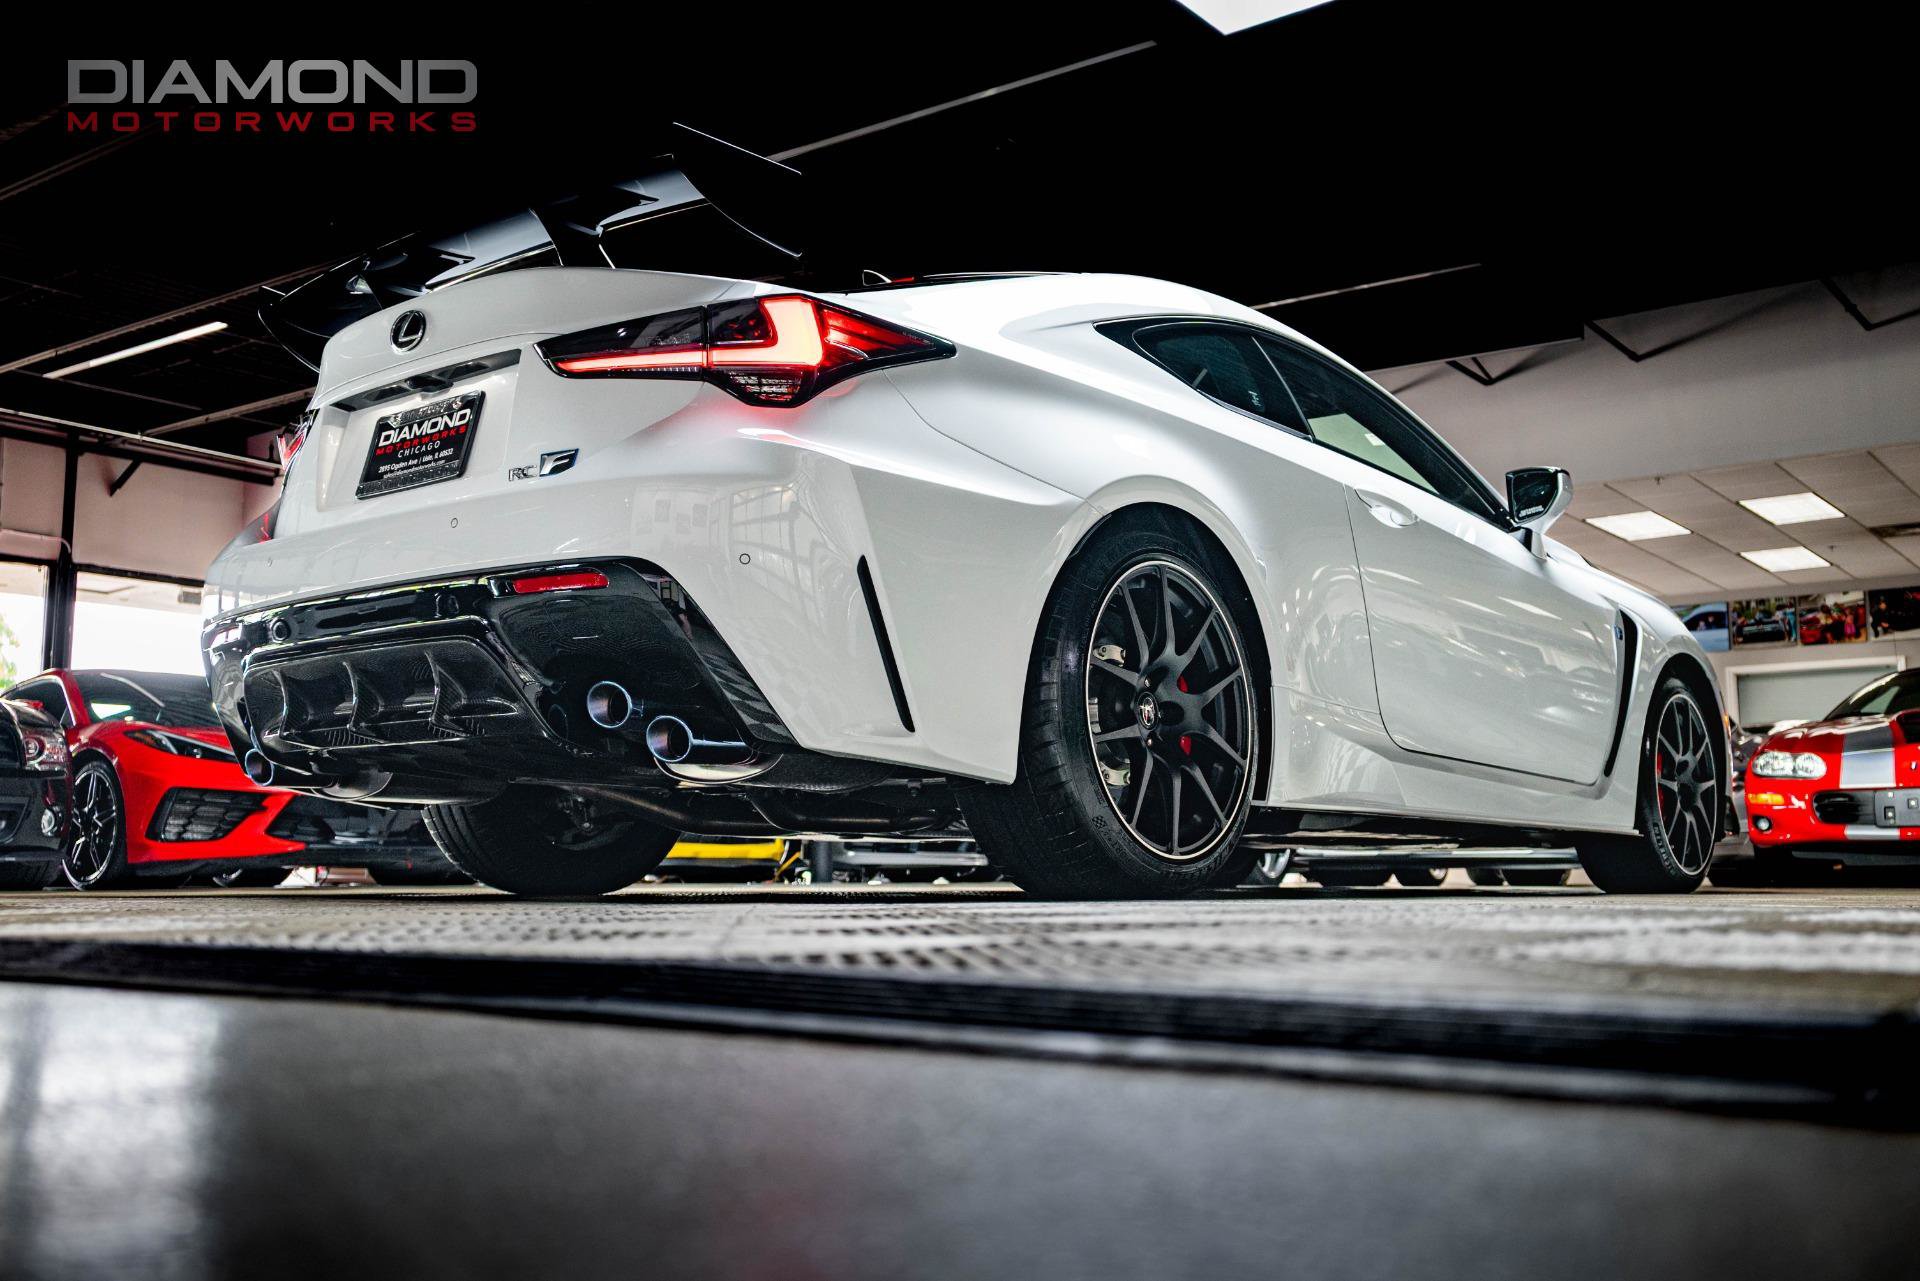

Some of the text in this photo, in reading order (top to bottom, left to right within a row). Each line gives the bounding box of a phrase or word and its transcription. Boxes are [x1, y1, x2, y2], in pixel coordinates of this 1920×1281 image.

[379, 409, 471, 446] DIAMOND
[375, 425, 468, 456] MOTORWORKS
[397, 440, 441, 458] CHICAGO
[508, 465, 537, 482] RC
